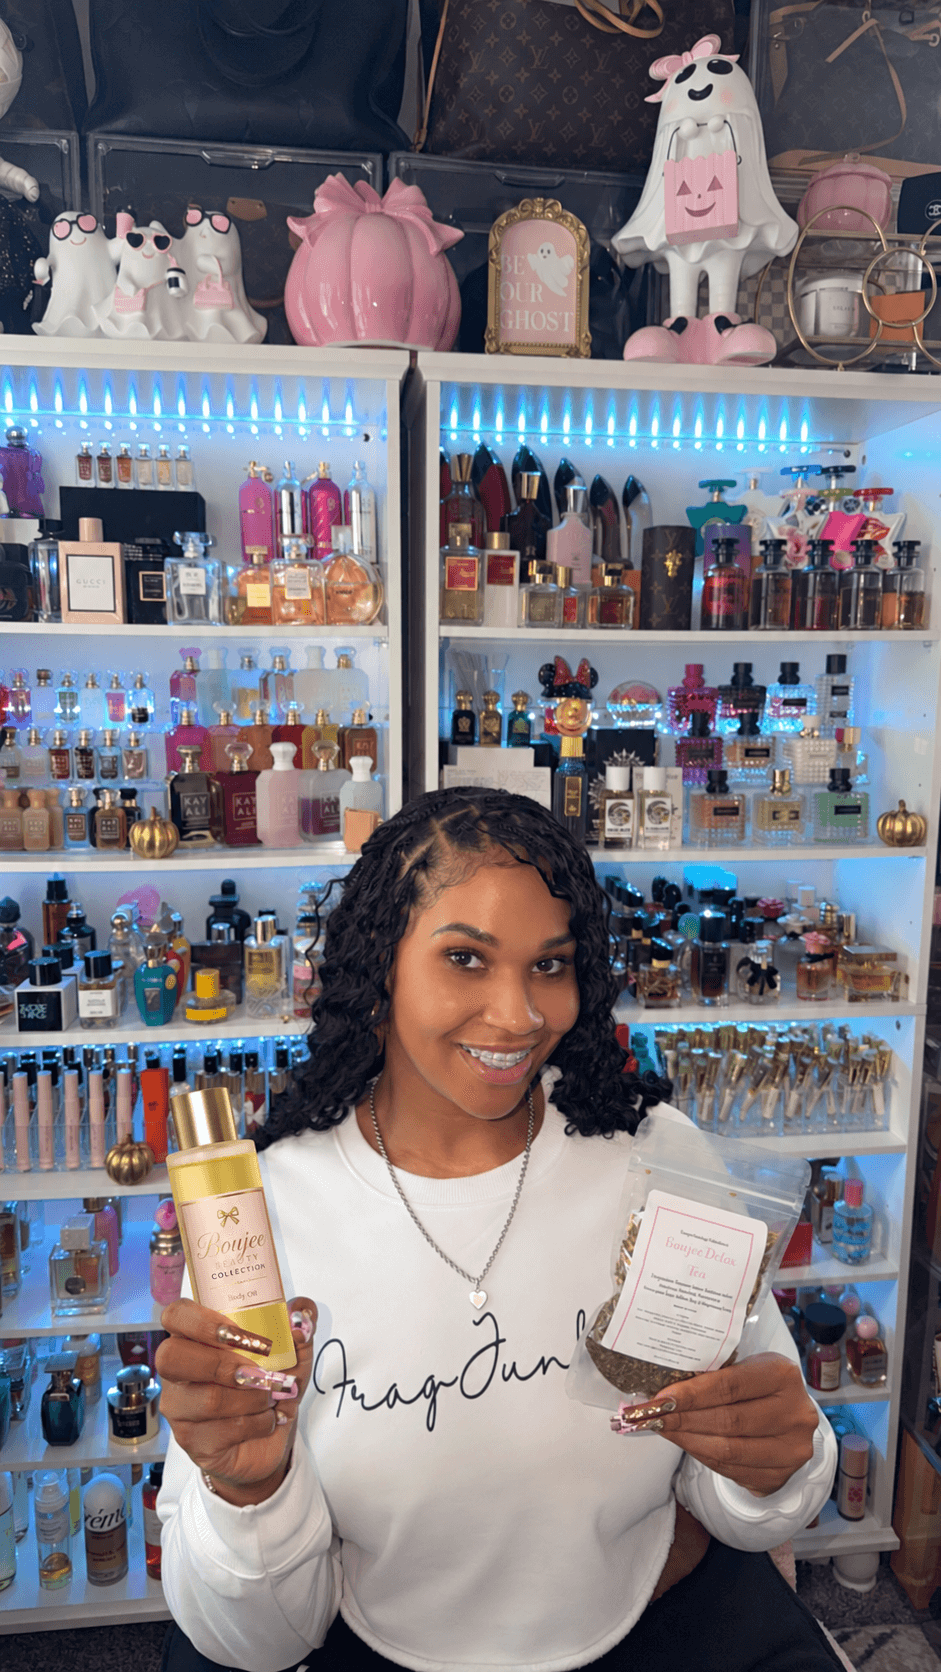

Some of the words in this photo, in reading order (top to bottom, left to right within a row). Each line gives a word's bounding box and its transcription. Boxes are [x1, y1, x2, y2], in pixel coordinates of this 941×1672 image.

[500, 254, 525, 275] BE
[500, 281, 543, 303] OUR
[500, 309, 574, 332] GHOST
[184, 796, 207, 806] KAY
[185, 807, 206, 816] ALI
[197, 1231, 266, 1264] Boujee
[211, 1263, 266, 1280] COLLECTION
[687, 1264, 707, 1279] Tea
[227, 1292, 245, 1302] Body
